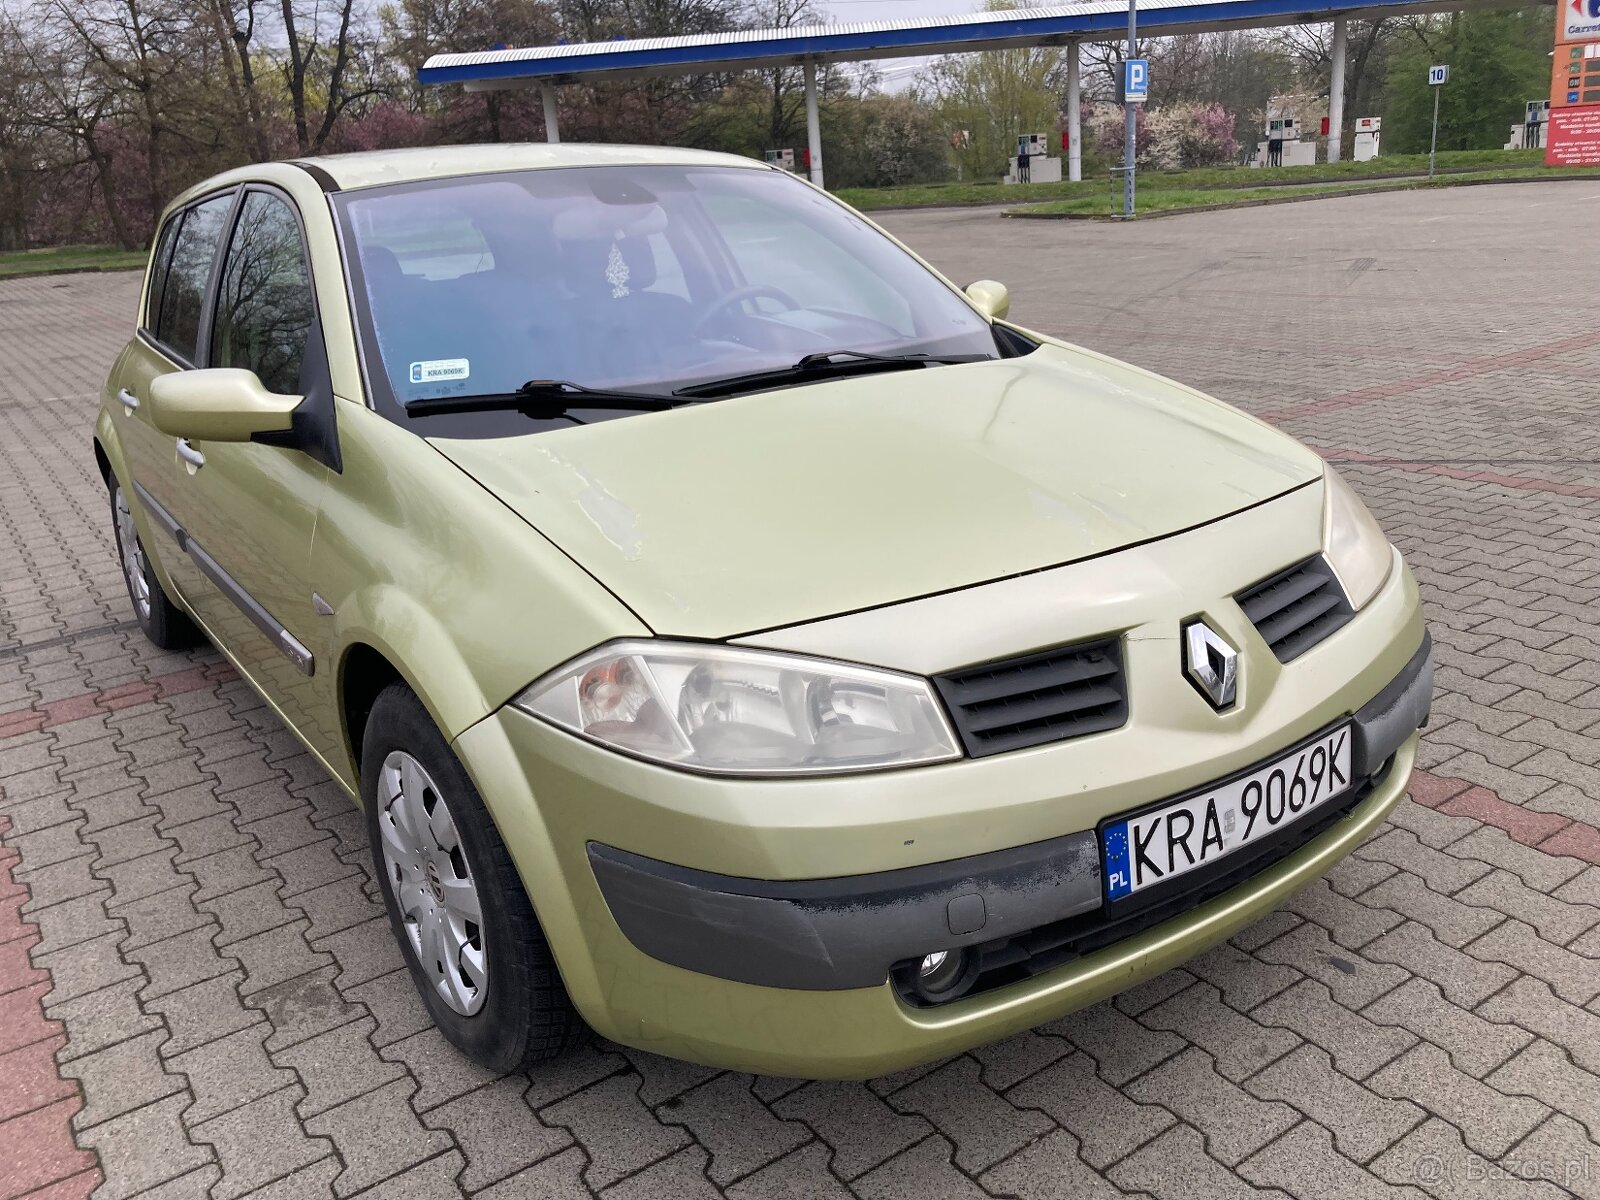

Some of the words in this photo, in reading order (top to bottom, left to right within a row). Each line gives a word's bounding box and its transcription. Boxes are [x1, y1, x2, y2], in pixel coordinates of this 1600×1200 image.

[1131, 64, 1143, 90] P
[1431, 69, 1443, 80] 10
[1133, 797, 1224, 886] KRA
[1240, 730, 1347, 841] 9069K
[1109, 873, 1128, 891] PL
